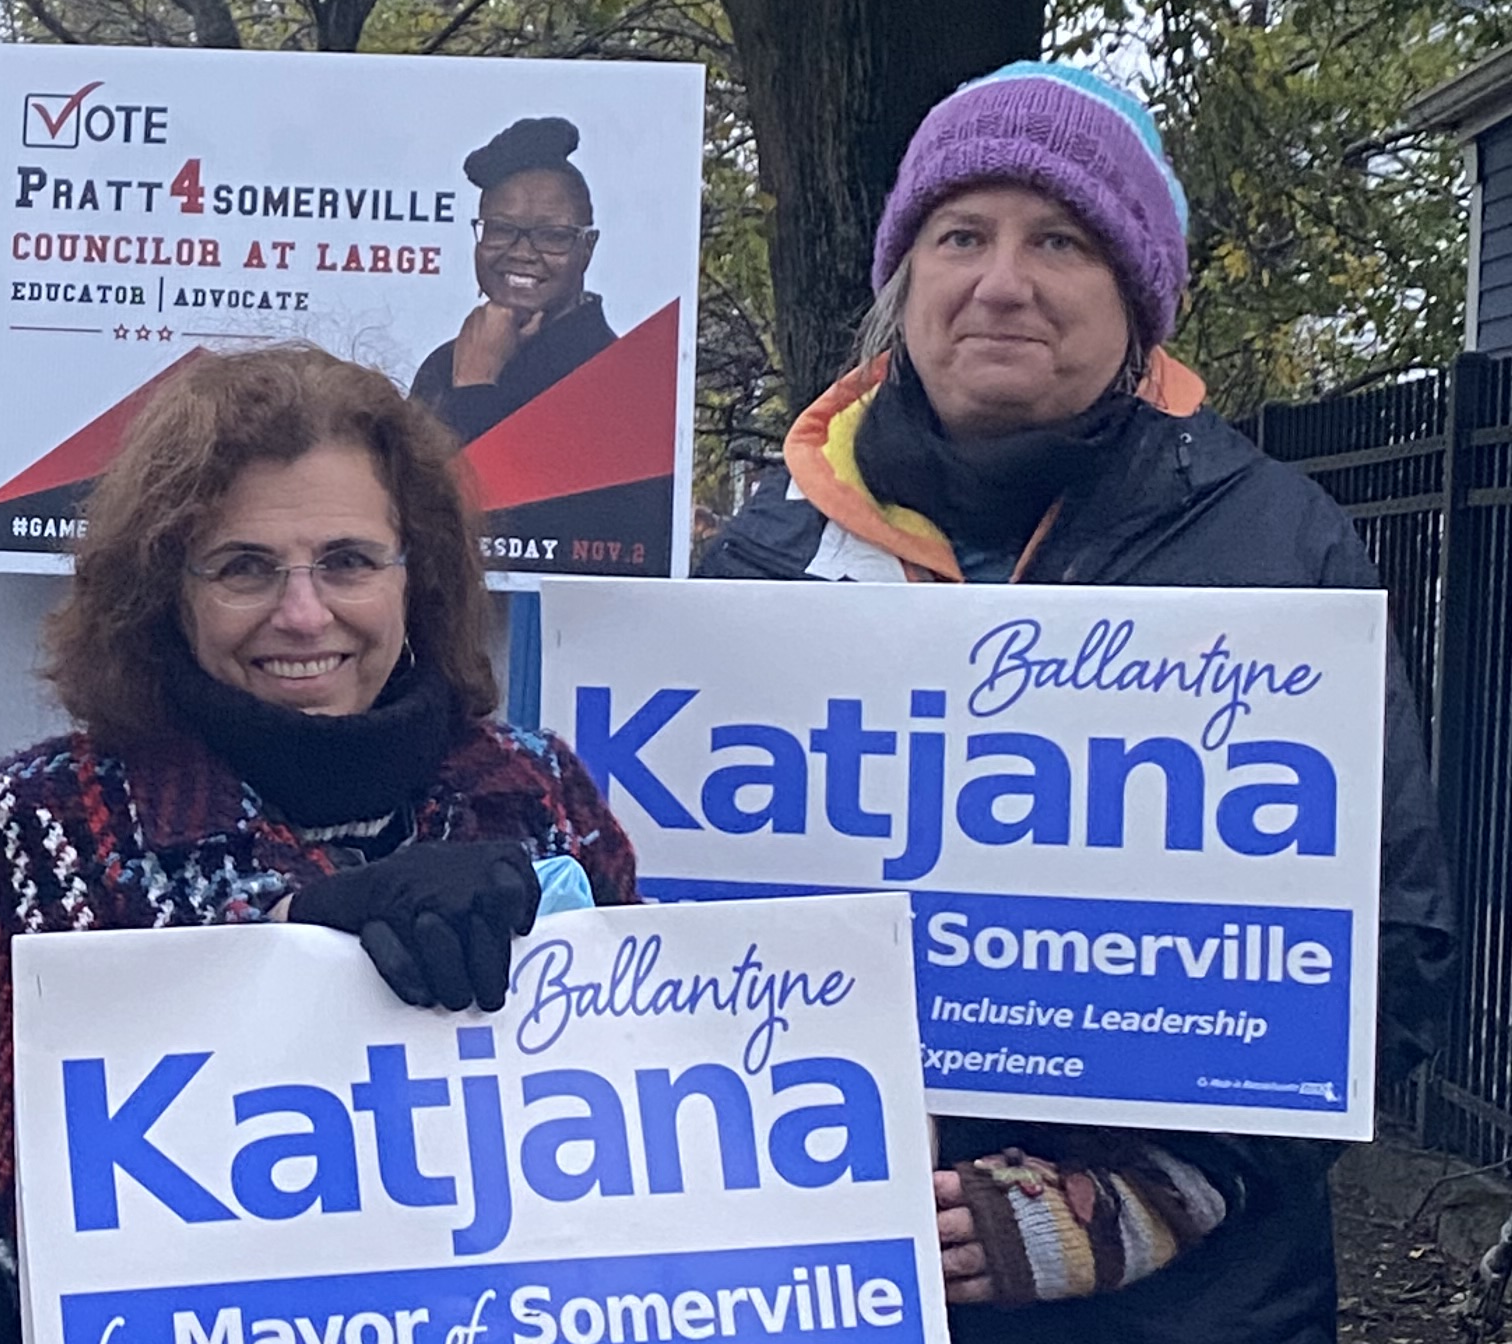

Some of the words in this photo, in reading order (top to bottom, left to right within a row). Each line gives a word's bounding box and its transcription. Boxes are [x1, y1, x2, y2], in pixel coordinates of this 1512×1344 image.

[11, 232, 221, 267] COUNCILOR
[243, 241, 296, 269] AT
[316, 243, 442, 275] LARGE
[11, 282, 146, 305] EDUCATOR
[173, 287, 310, 311] ADVOCATE
[479, 537, 559, 560] ESDAY
[968, 618, 1323, 751] Ballantyne
[575, 687, 1337, 881] Katjana
[927, 912, 1332, 986] Somerville
[512, 934, 856, 1075] Ballantyne
[931, 996, 1075, 1031] Inclusive
[1083, 1005, 1268, 1043] Leadership
[921, 1043, 1085, 1078] xperience
[61, 1027, 889, 1256] Katjana
